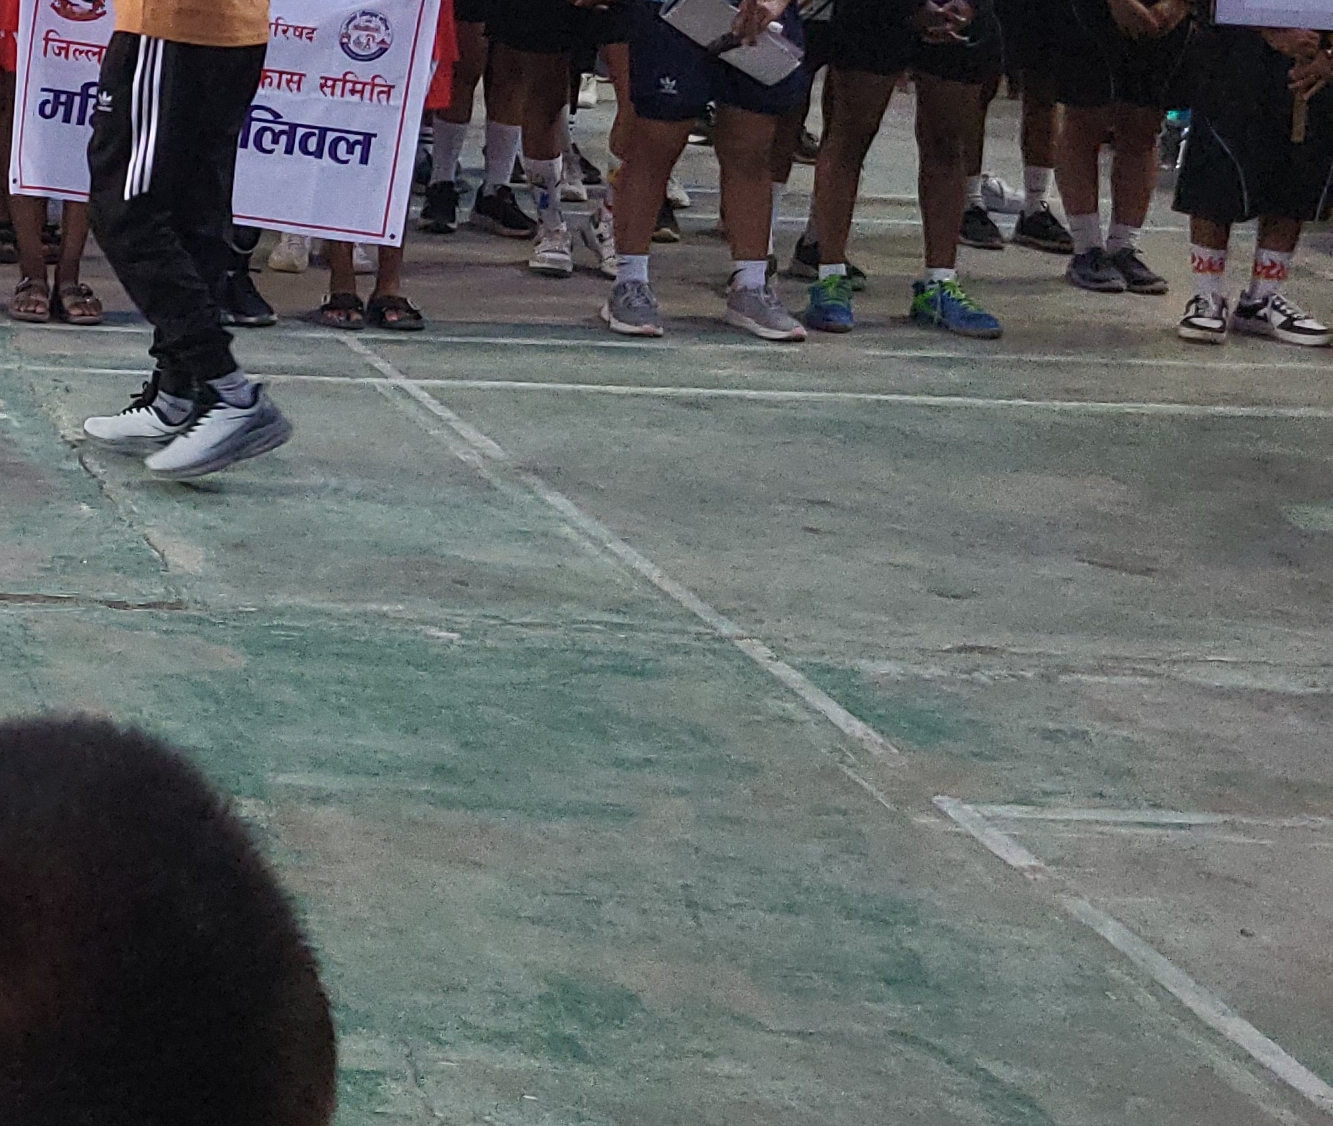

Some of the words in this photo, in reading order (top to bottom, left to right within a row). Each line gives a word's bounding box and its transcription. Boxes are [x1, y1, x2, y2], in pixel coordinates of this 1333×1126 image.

[268, 16, 319, 43] रिषद
[42, 28, 107, 64] जिल्ल
[260, 67, 307, 93] कास
[318, 71, 396, 104] समिति
[238, 104, 378, 167] लिवल
